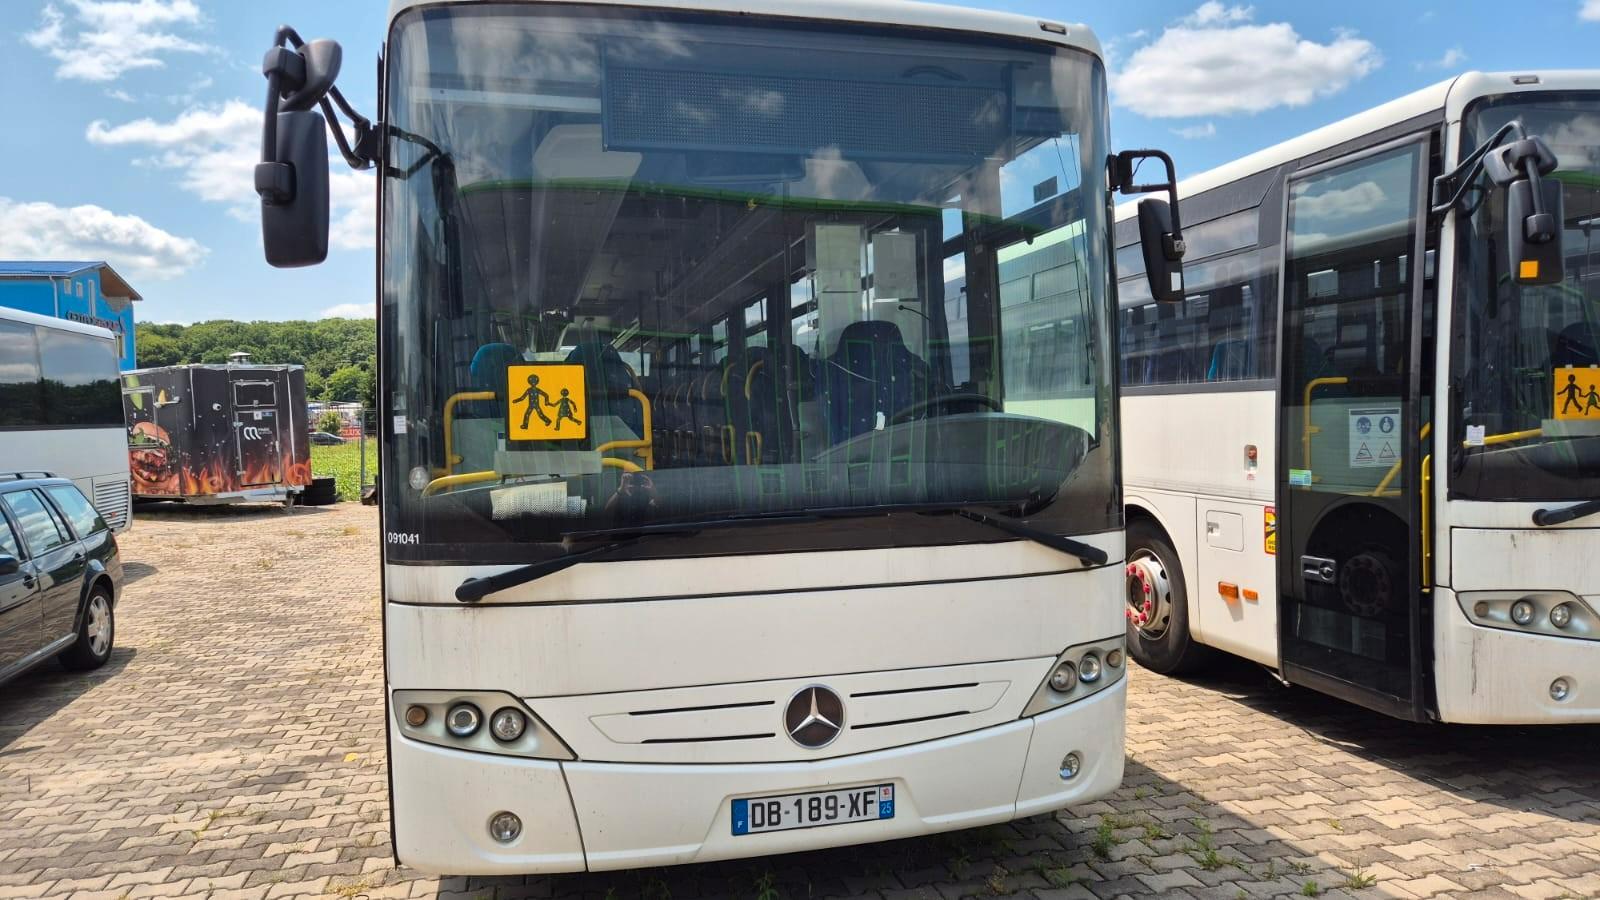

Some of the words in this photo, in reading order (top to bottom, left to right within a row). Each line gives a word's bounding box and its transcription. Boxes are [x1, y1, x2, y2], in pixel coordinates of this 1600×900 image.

[387, 531, 420, 545] 091041
[751, 790, 876, 829] DB-189-XF
[880, 802, 892, 815] 25
[737, 820, 744, 829] F
